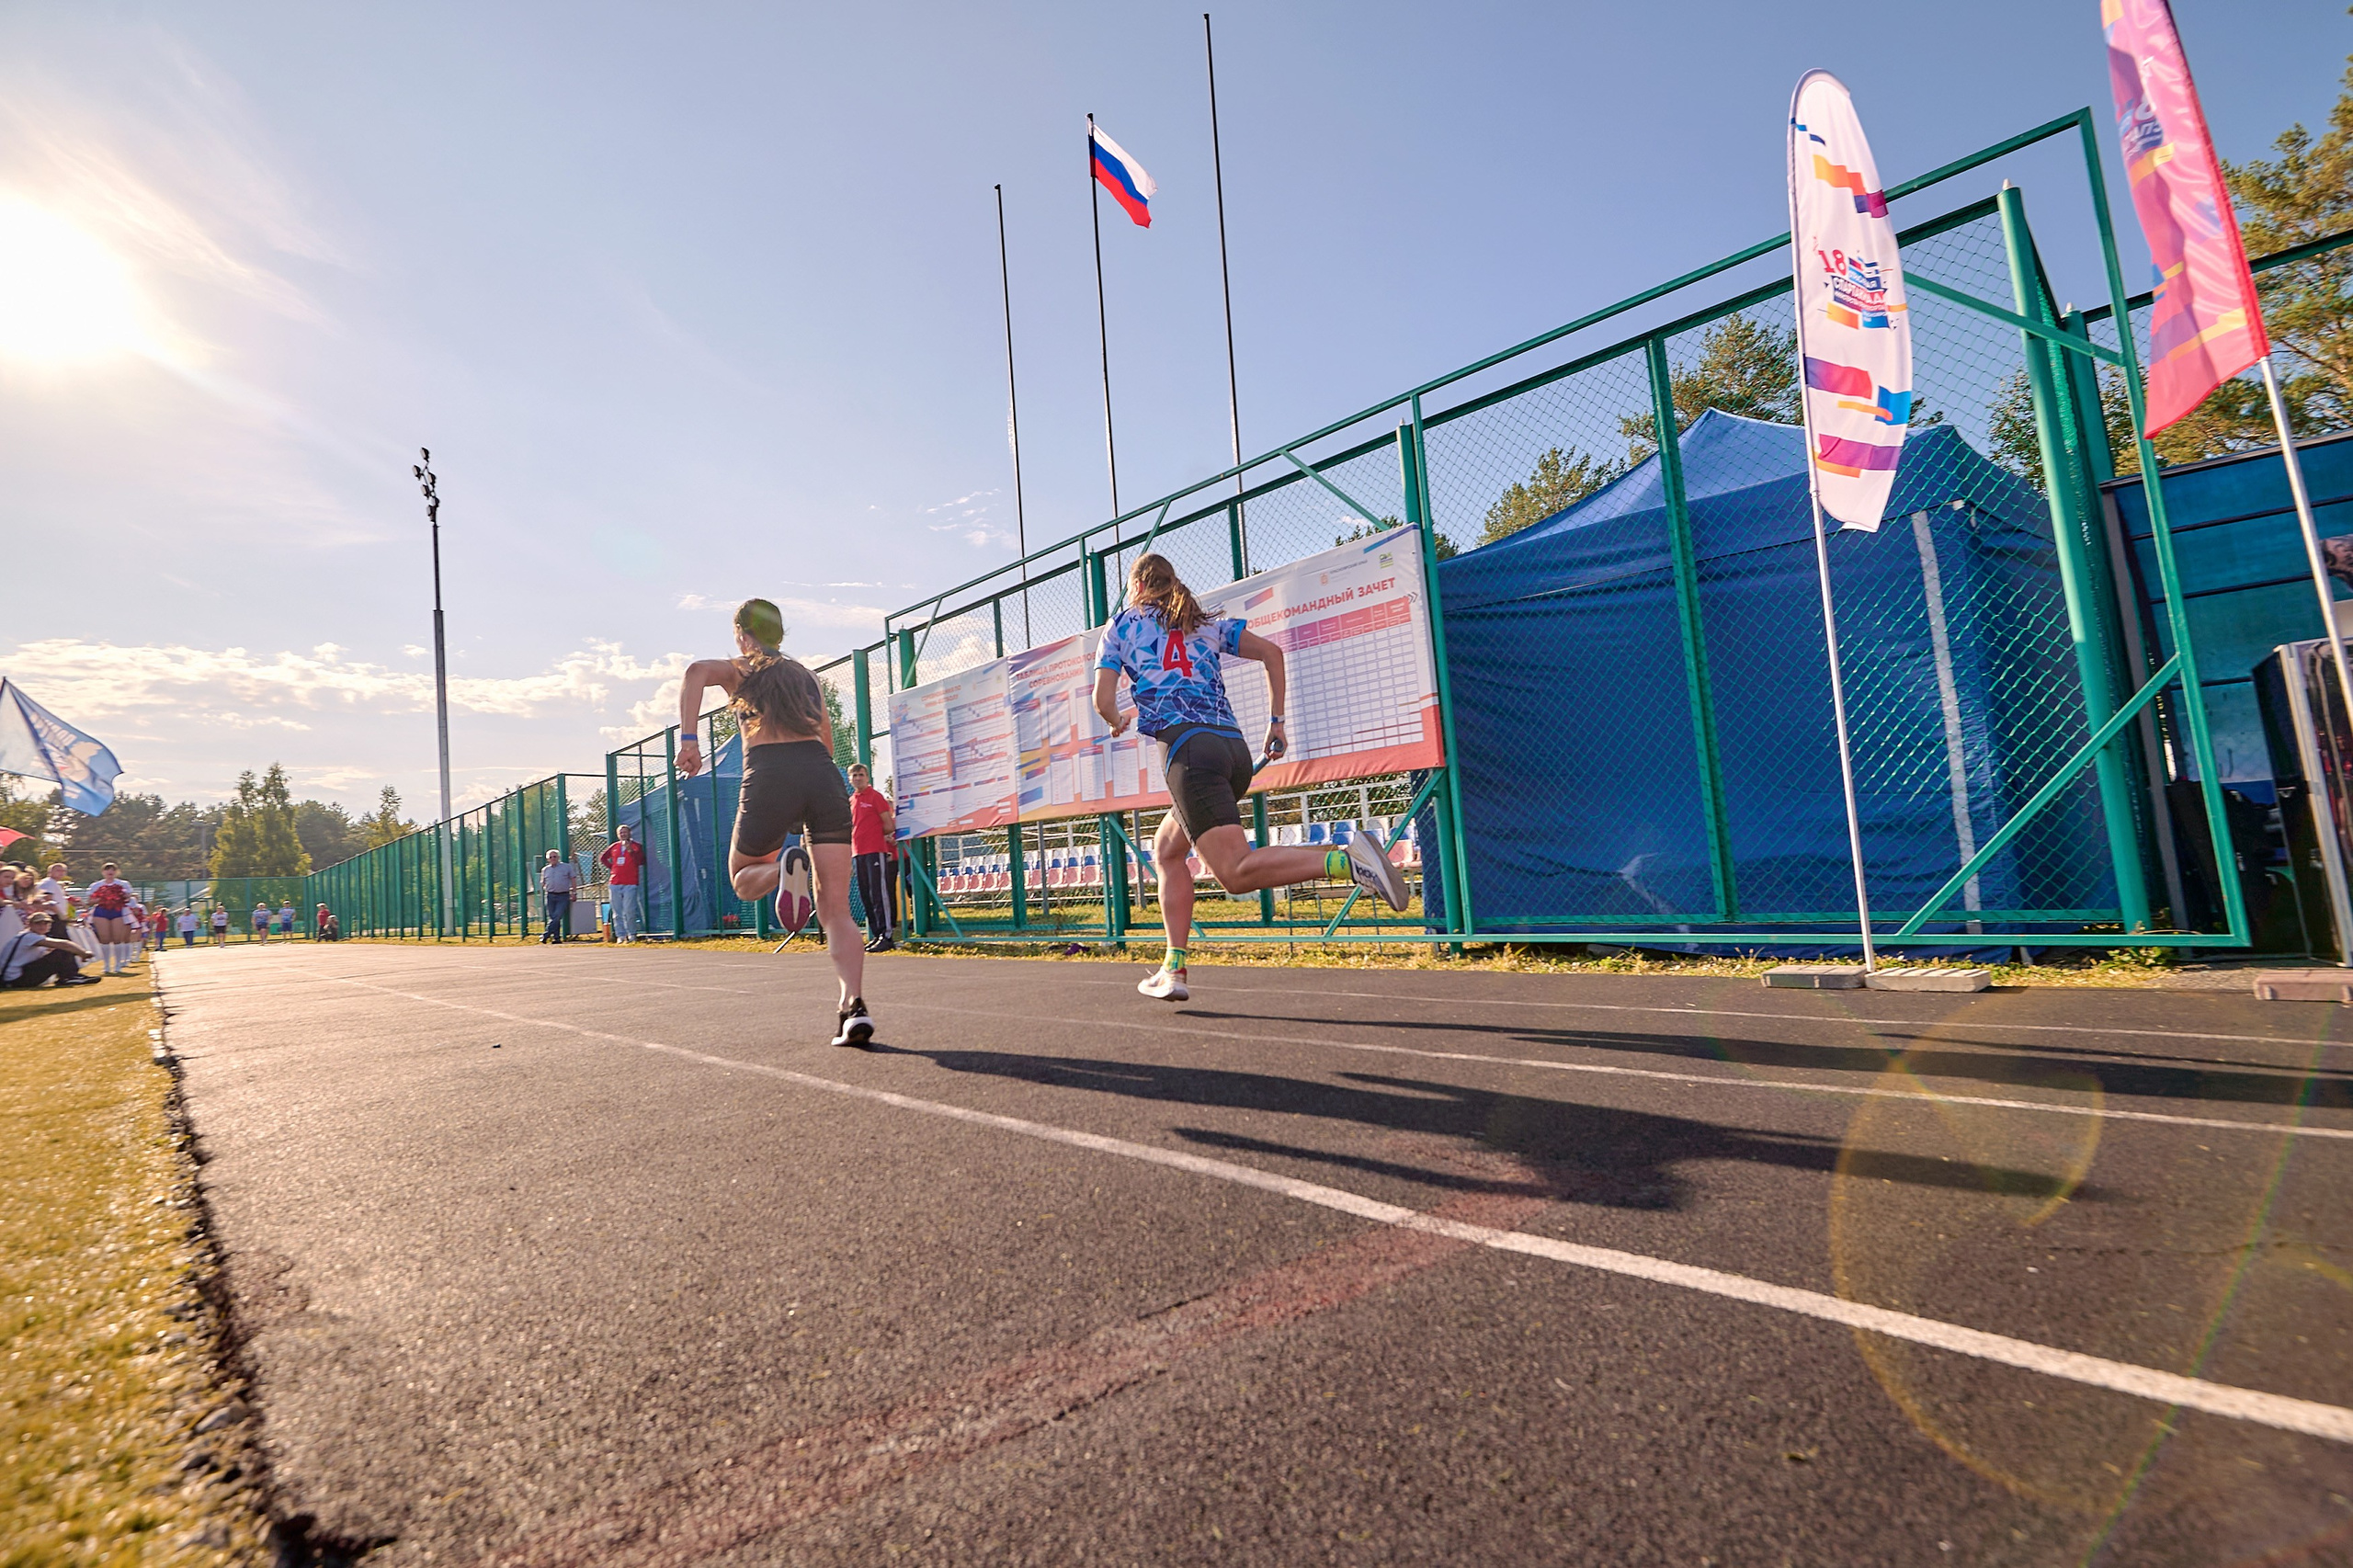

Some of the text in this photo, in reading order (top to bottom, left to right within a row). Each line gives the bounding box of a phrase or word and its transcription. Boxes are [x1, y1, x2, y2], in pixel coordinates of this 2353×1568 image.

[1818, 249, 1847, 276] 18
[1247, 586, 1354, 630] ОБЩЕКОМАНДНЫЙ
[1358, 576, 1396, 597] ЗАЧЕТ
[1163, 629, 1193, 677] 4
[1016, 665, 1048, 681] ТАБЛИЦА
[1029, 665, 1085, 688] СОРЕВНОВАНИЙ
